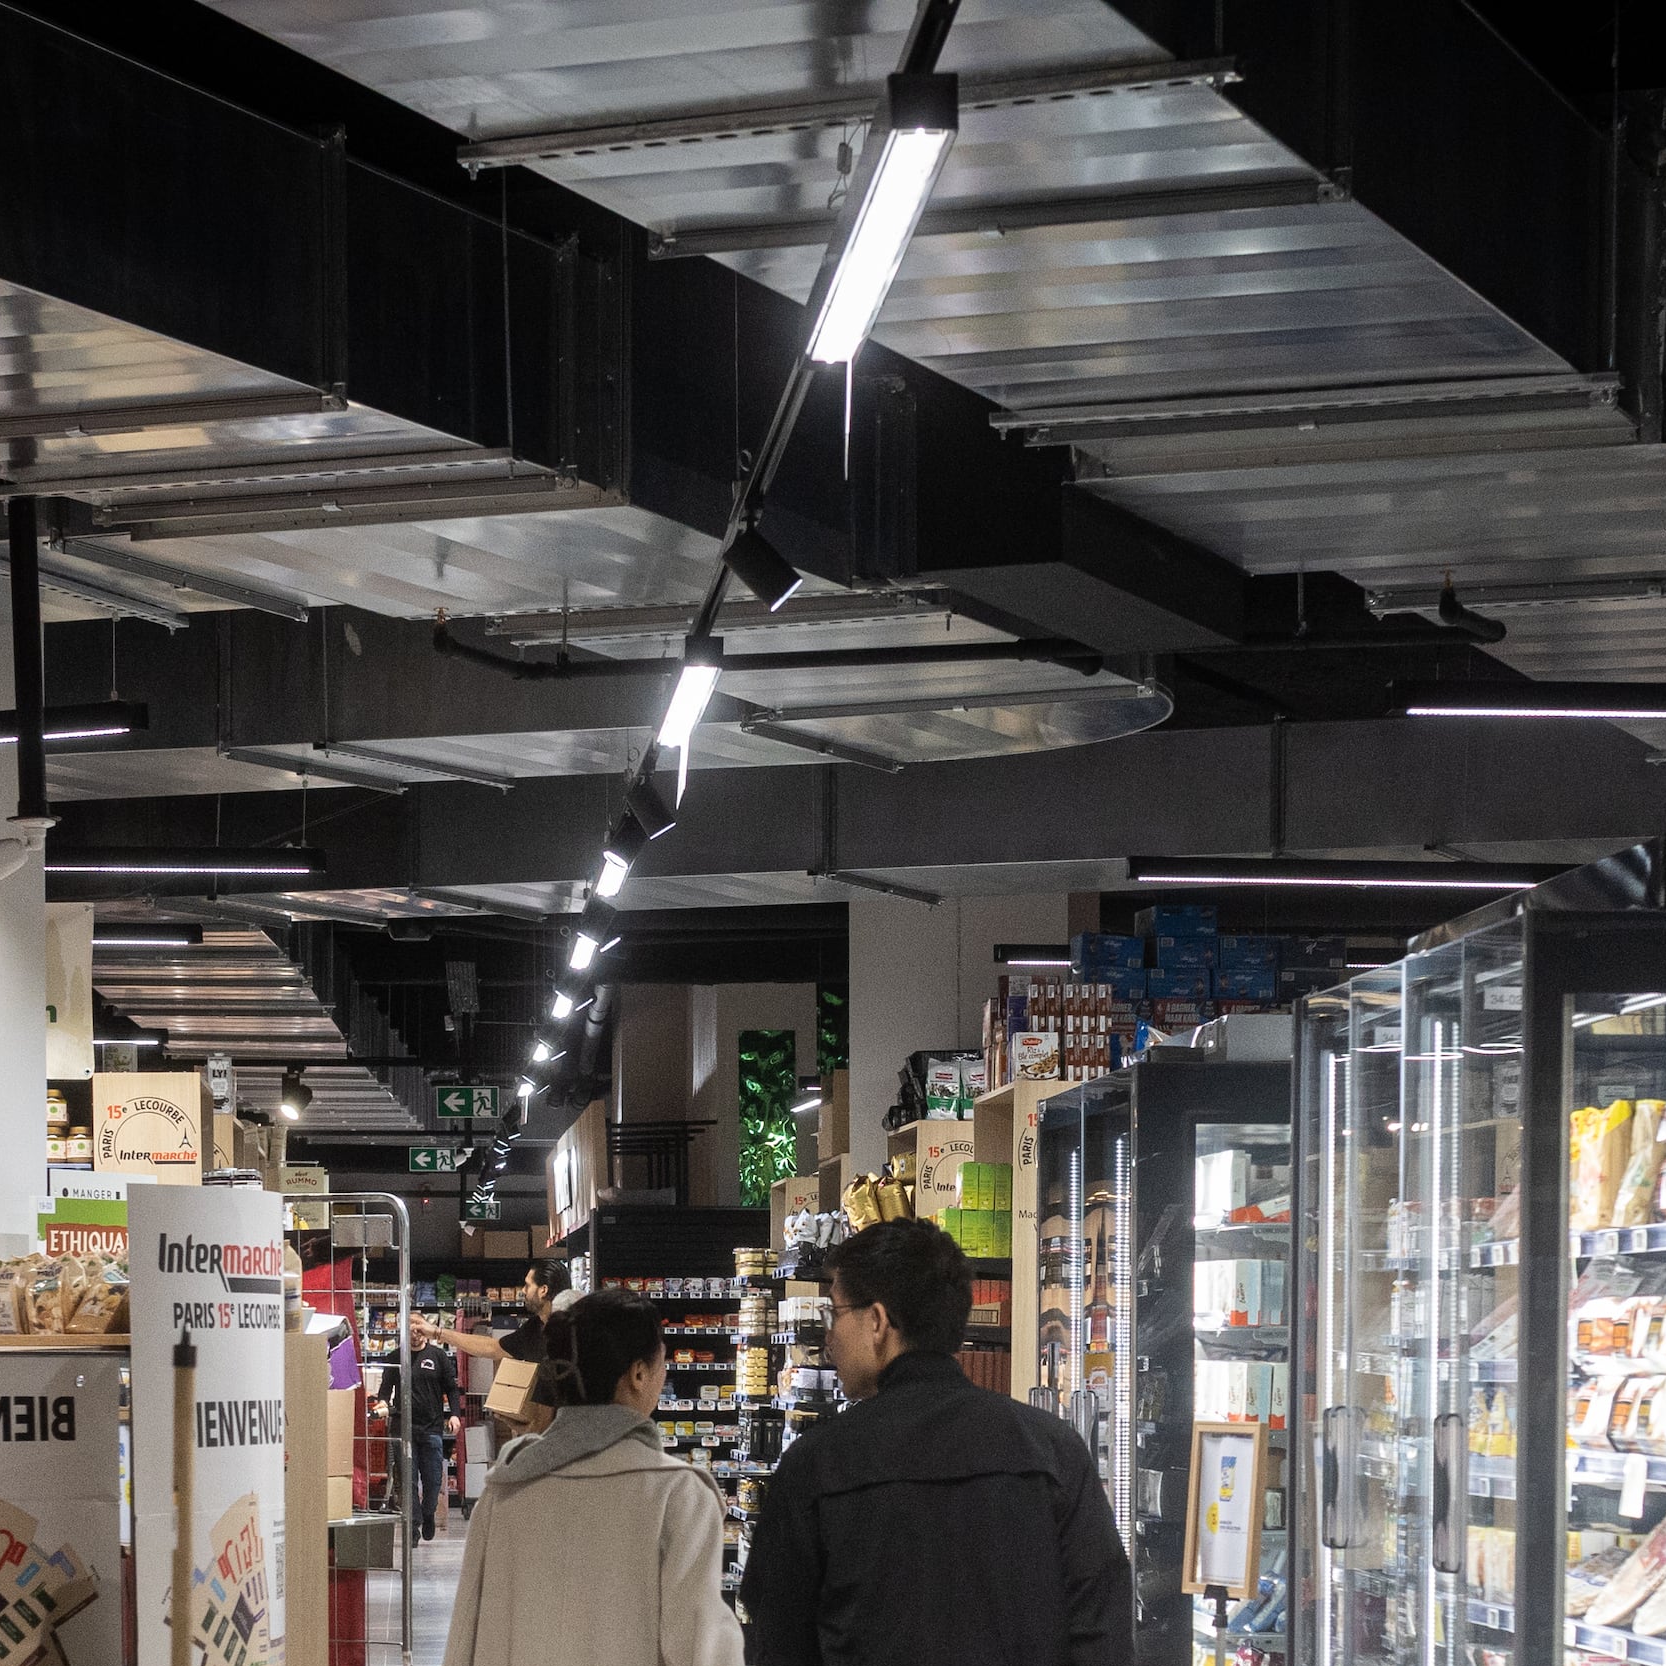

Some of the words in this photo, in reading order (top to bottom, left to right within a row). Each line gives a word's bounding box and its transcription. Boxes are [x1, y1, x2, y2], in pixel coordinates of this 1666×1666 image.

[103, 1128, 114, 1159] PARIS
[134, 1100, 185, 1125] LECOURBE
[120, 1150, 198, 1162] Intermarché
[1023, 1136, 1034, 1165] PARIS
[285, 1177, 317, 1187] RUMMO
[924, 1165, 933, 1190] PARIS
[73, 1187, 112, 1200] MANGER
[174, 1303, 215, 1329] PARIS
[196, 1400, 282, 1448] IENVENUE
